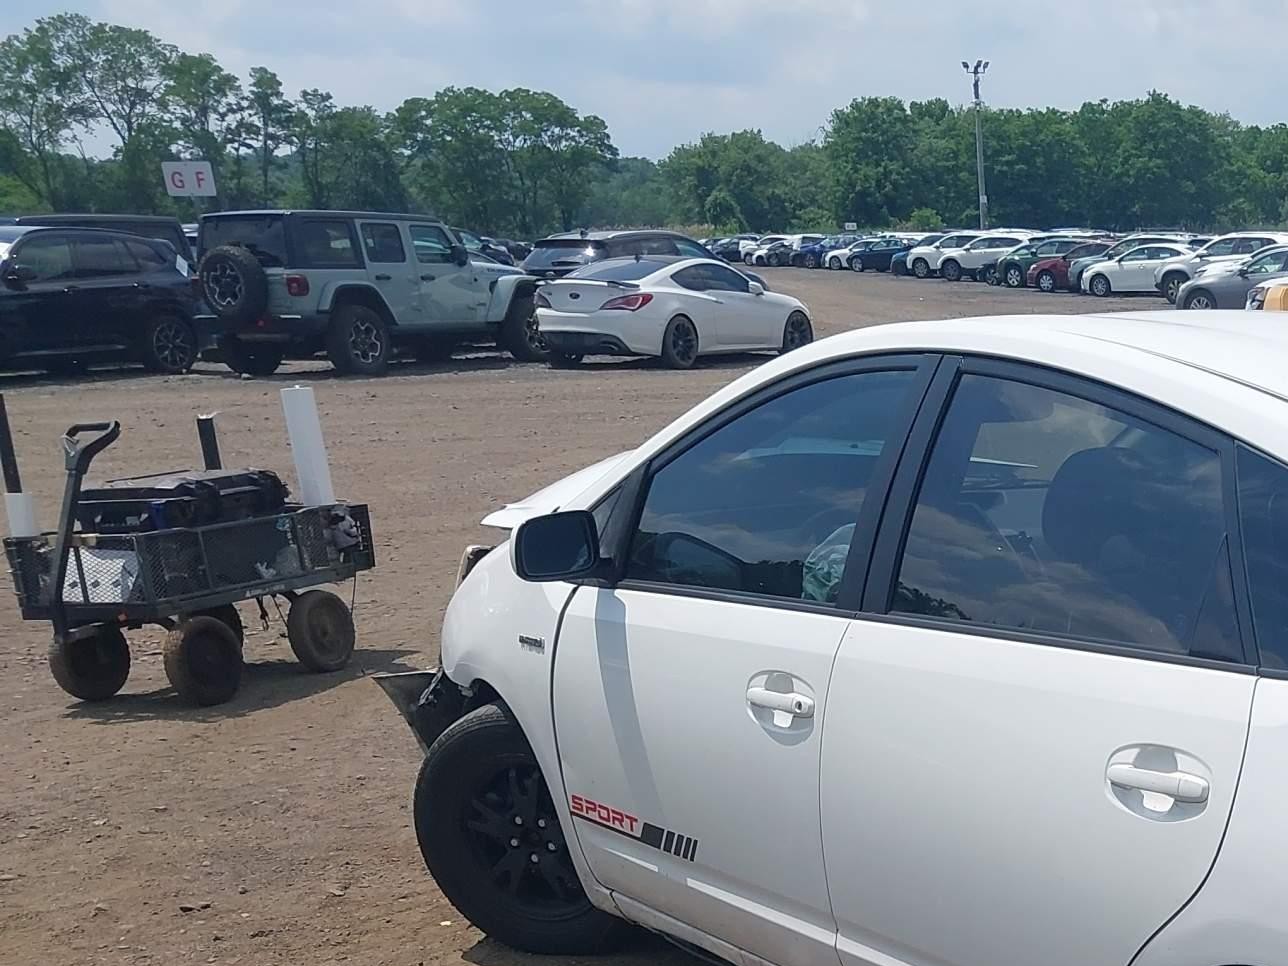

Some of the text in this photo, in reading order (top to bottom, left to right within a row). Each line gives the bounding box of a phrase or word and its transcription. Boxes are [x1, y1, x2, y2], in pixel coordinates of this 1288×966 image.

[171, 171, 205, 189] G F
[571, 794, 639, 832] SPORT
